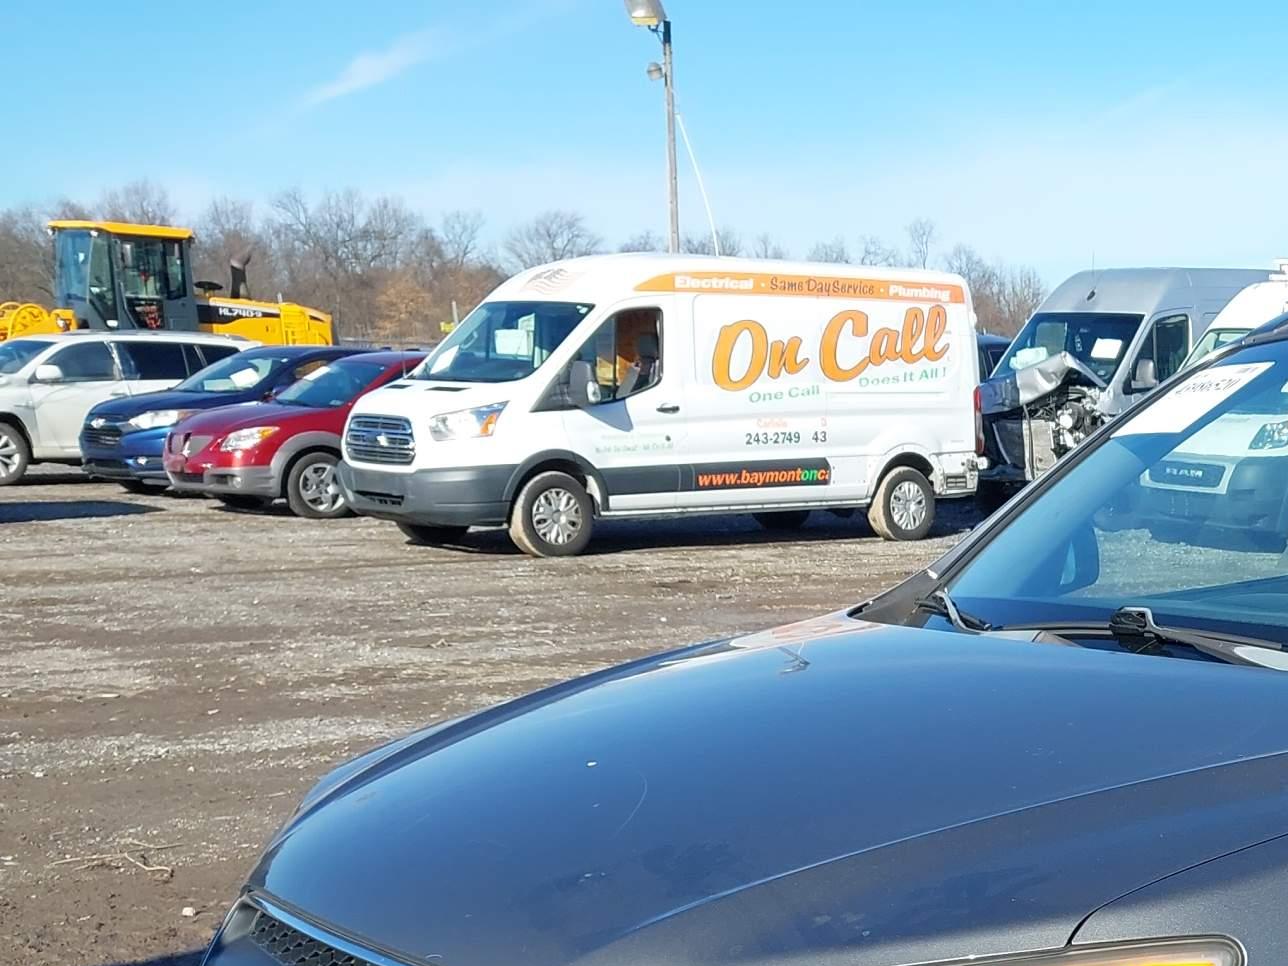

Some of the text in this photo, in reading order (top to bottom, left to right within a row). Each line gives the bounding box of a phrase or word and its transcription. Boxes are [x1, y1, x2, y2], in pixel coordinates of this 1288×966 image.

[675, 276, 951, 302] Electrical Same Day Service Plumbing
[711, 304, 950, 392] On Call
[748, 390, 784, 404] One
[788, 384, 821, 399] Call
[858, 374, 900, 388] Does
[903, 372, 914, 383] It
[745, 430, 827, 446] 243-2749 43
[1165, 467, 1204, 478] RAM
